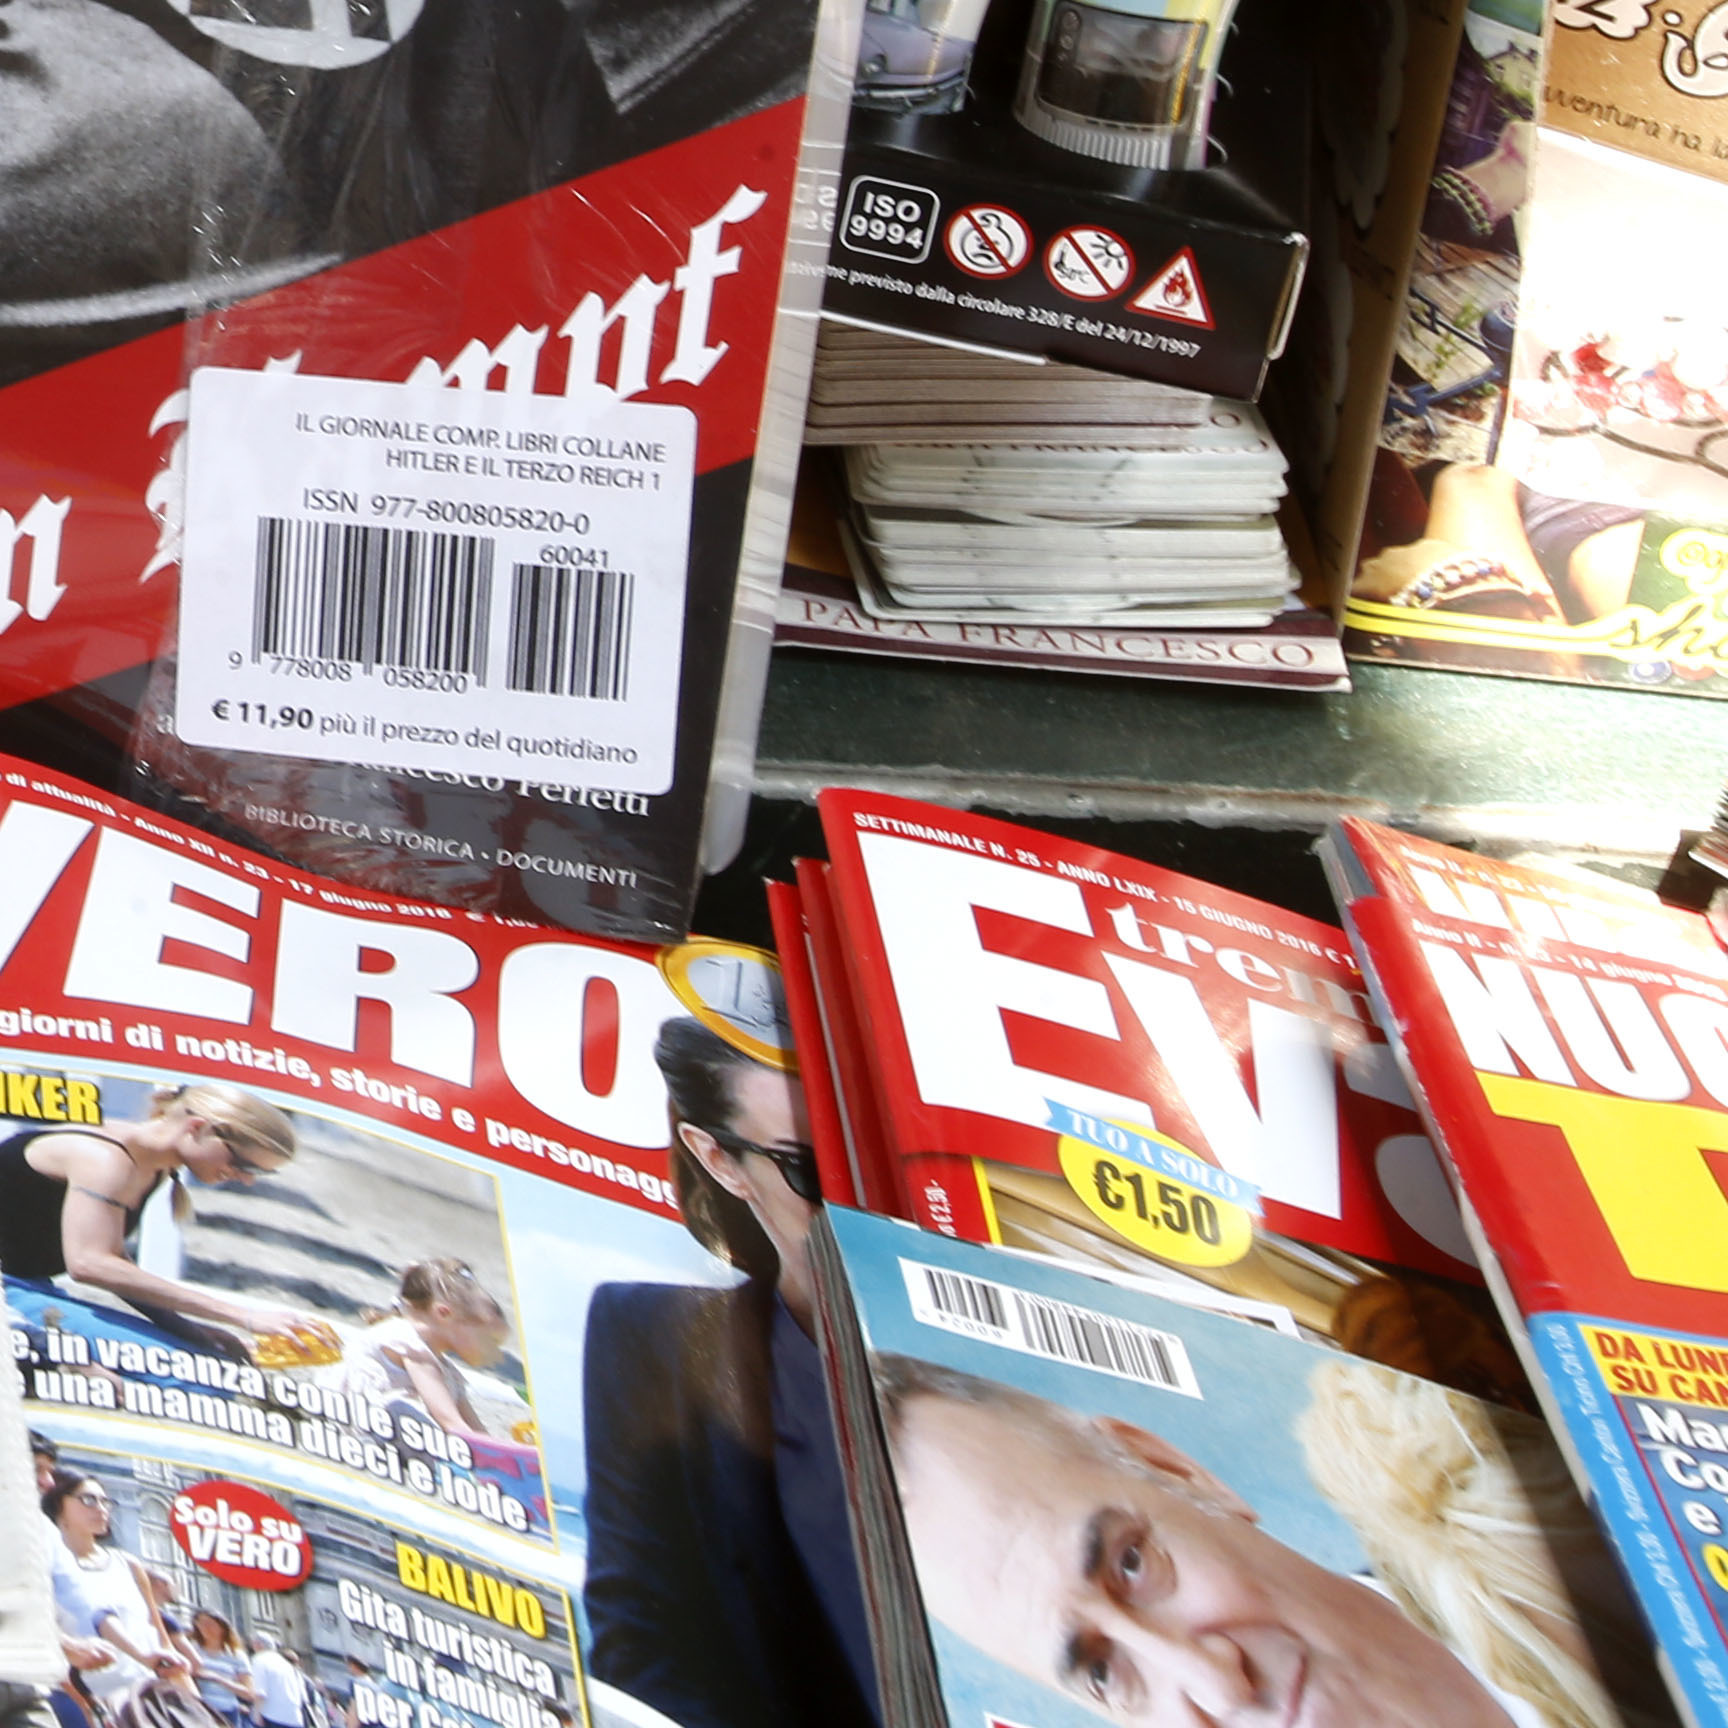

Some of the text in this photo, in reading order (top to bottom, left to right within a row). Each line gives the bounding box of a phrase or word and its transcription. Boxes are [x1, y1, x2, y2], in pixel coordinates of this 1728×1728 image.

[849, 214, 925, 251] 9994
[861, 190, 923, 224] ISO
[848, 268, 1202, 359] previsto dalla circolare 328/E del 24/12/1997
[295, 411, 667, 464] IL GIORNALE COMP. LIBRI COLLANE
[302, 487, 590, 536] ISSN 977-800805820-0
[958, 622, 1314, 669] FRANCESCO
[211, 697, 639, 766] € 11,90 più il prezzo del quotidiano
[245, 803, 639, 889] BIBLIOTECA STORICA DOCUMENTI
[853, 811, 1324, 958] SETTIMANALE N. 25 ANNO LXIX 15 GIUGNO 2016
[125, 1021, 164, 1052] di
[176, 1033, 323, 1090] notizie,
[330, 1065, 444, 1122] storie
[452, 1107, 476, 1133] e
[1067, 1107, 1242, 1200] TUO A SOLO
[1093, 1159, 1222, 1247] €1,50
[172, 1496, 304, 1545] Solo su
[185, 1525, 304, 1578] VERO
[393, 1540, 549, 1640] BALIVO
